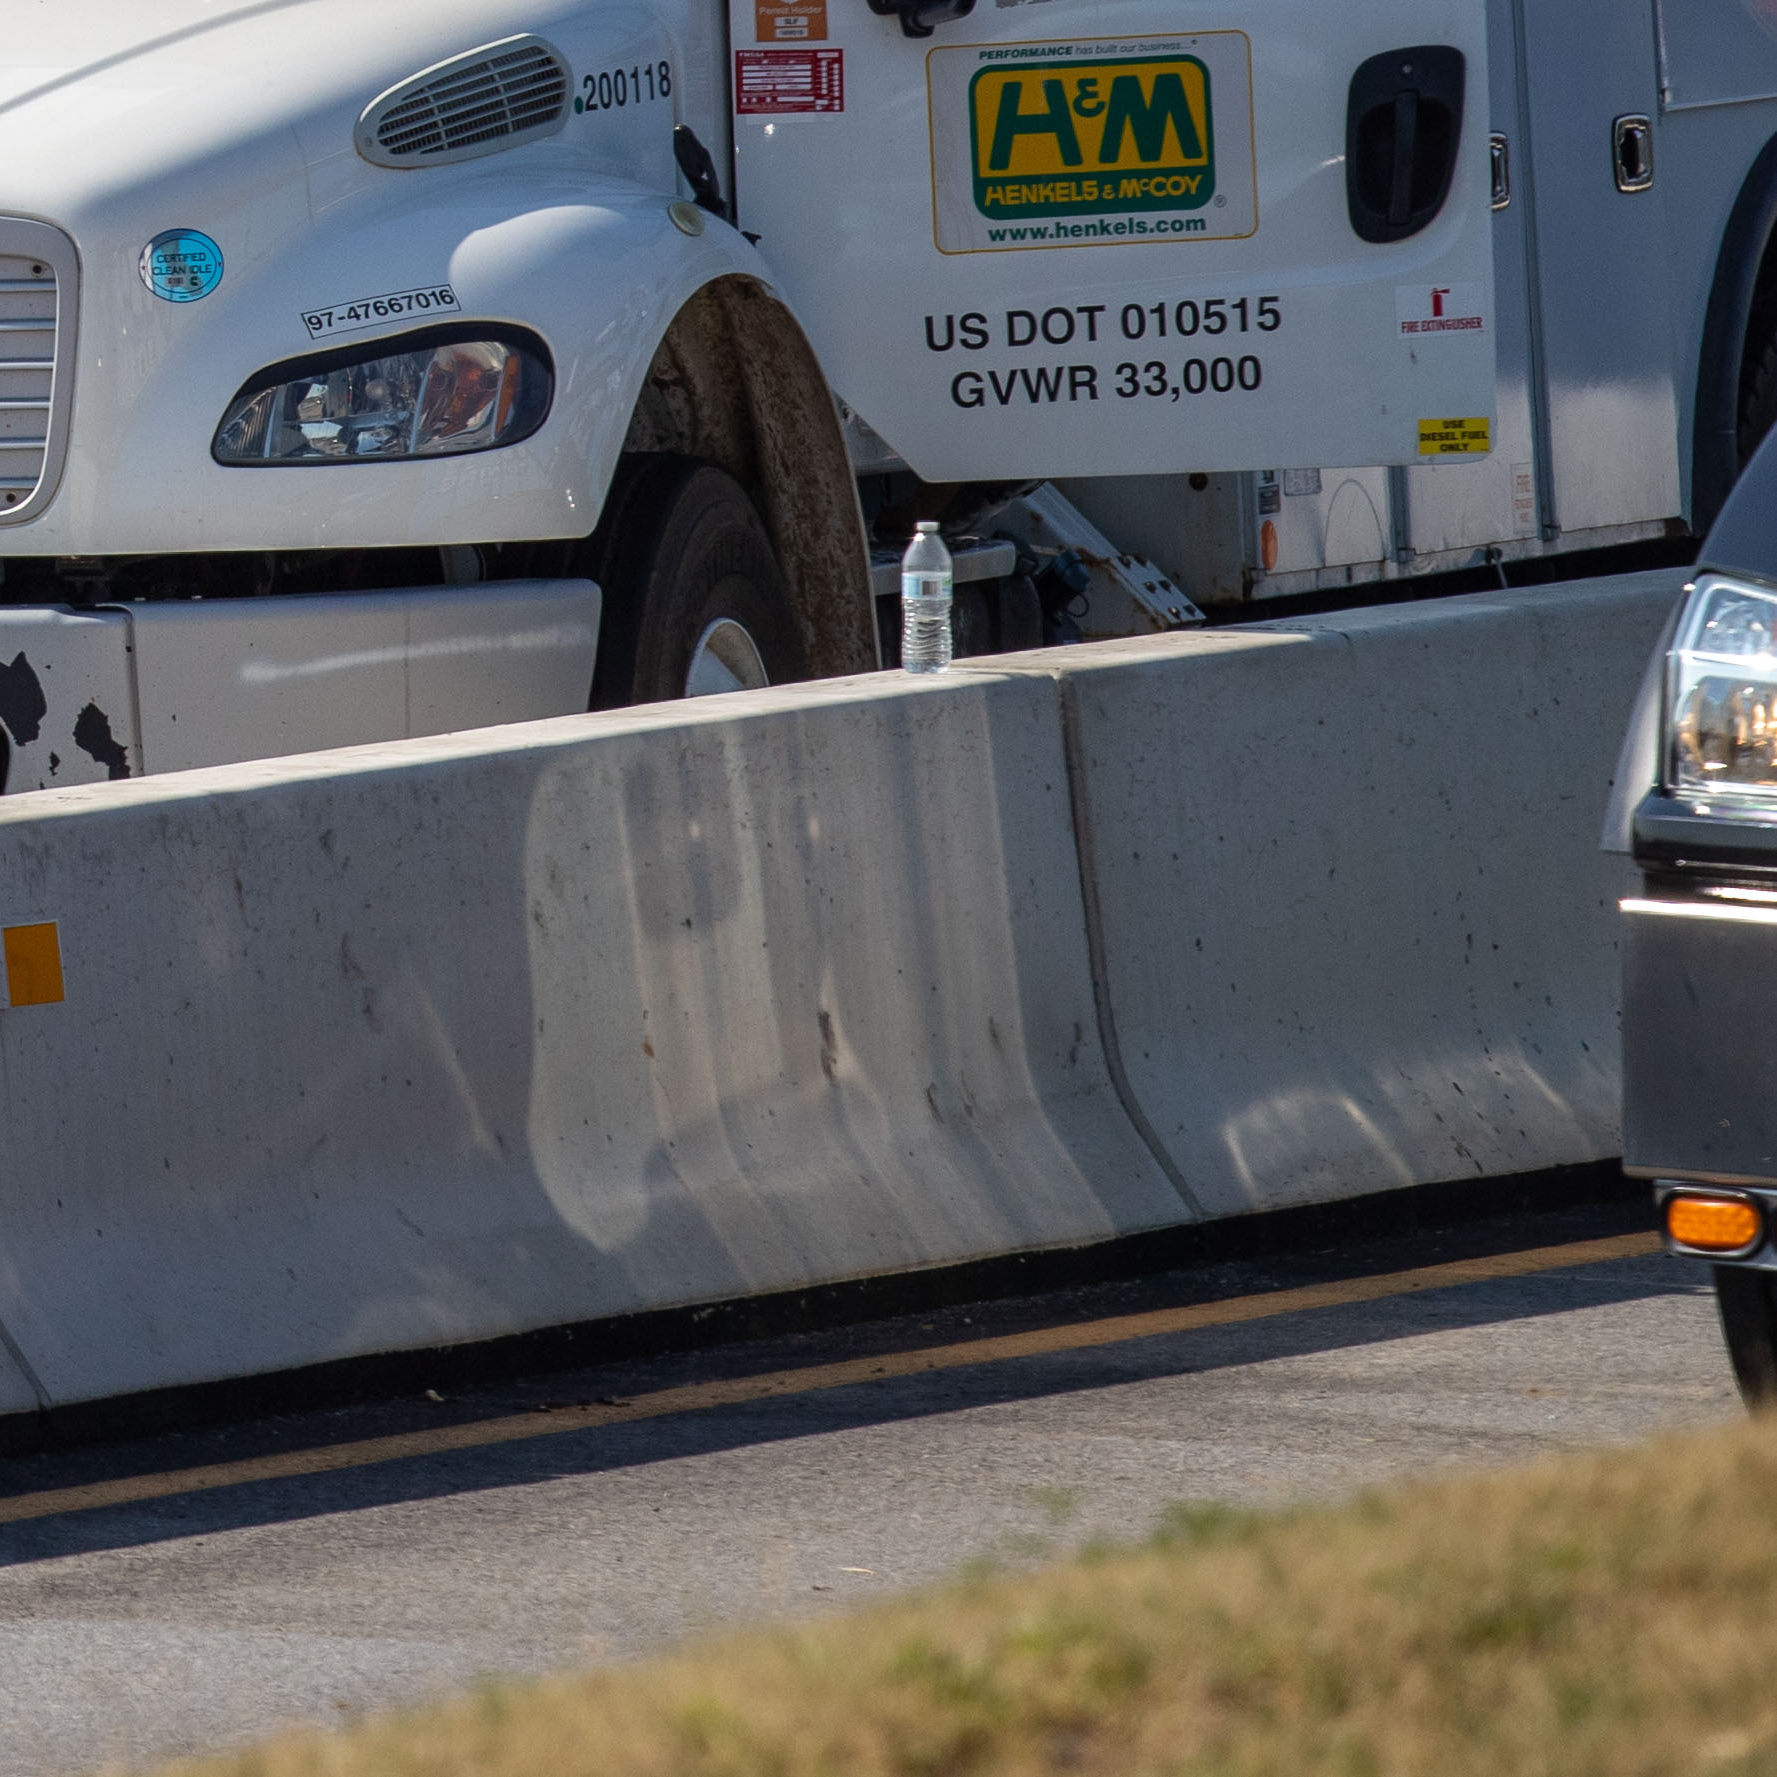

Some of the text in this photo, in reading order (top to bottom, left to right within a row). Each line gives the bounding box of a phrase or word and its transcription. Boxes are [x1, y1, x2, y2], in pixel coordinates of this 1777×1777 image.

[978, 45, 1073, 61] PERFORMANCE
[1075, 46, 1093, 55] has
[1096, 44, 1118, 54] built
[1119, 44, 1136, 53] our
[583, 60, 671, 112] 200118
[988, 72, 1204, 172] H&M
[984, 174, 1203, 207] HENKELS & McCOY
[988, 216, 1207, 243] www.henkels.com
[156, 252, 206, 264] CERTIFIED
[152, 266, 186, 276] CLEAN
[307, 288, 455, 331] 97-47667016
[924, 295, 1281, 352] US DOT 010515
[1401, 316, 1483, 334] FIRE EXTINGUISHER
[951, 354, 1263, 409] GVWR 33,000
[1443, 419, 1465, 429] USE
[1420, 430, 1488, 442] DIESEL FUEL
[1440, 442, 1469, 453] ONLY
